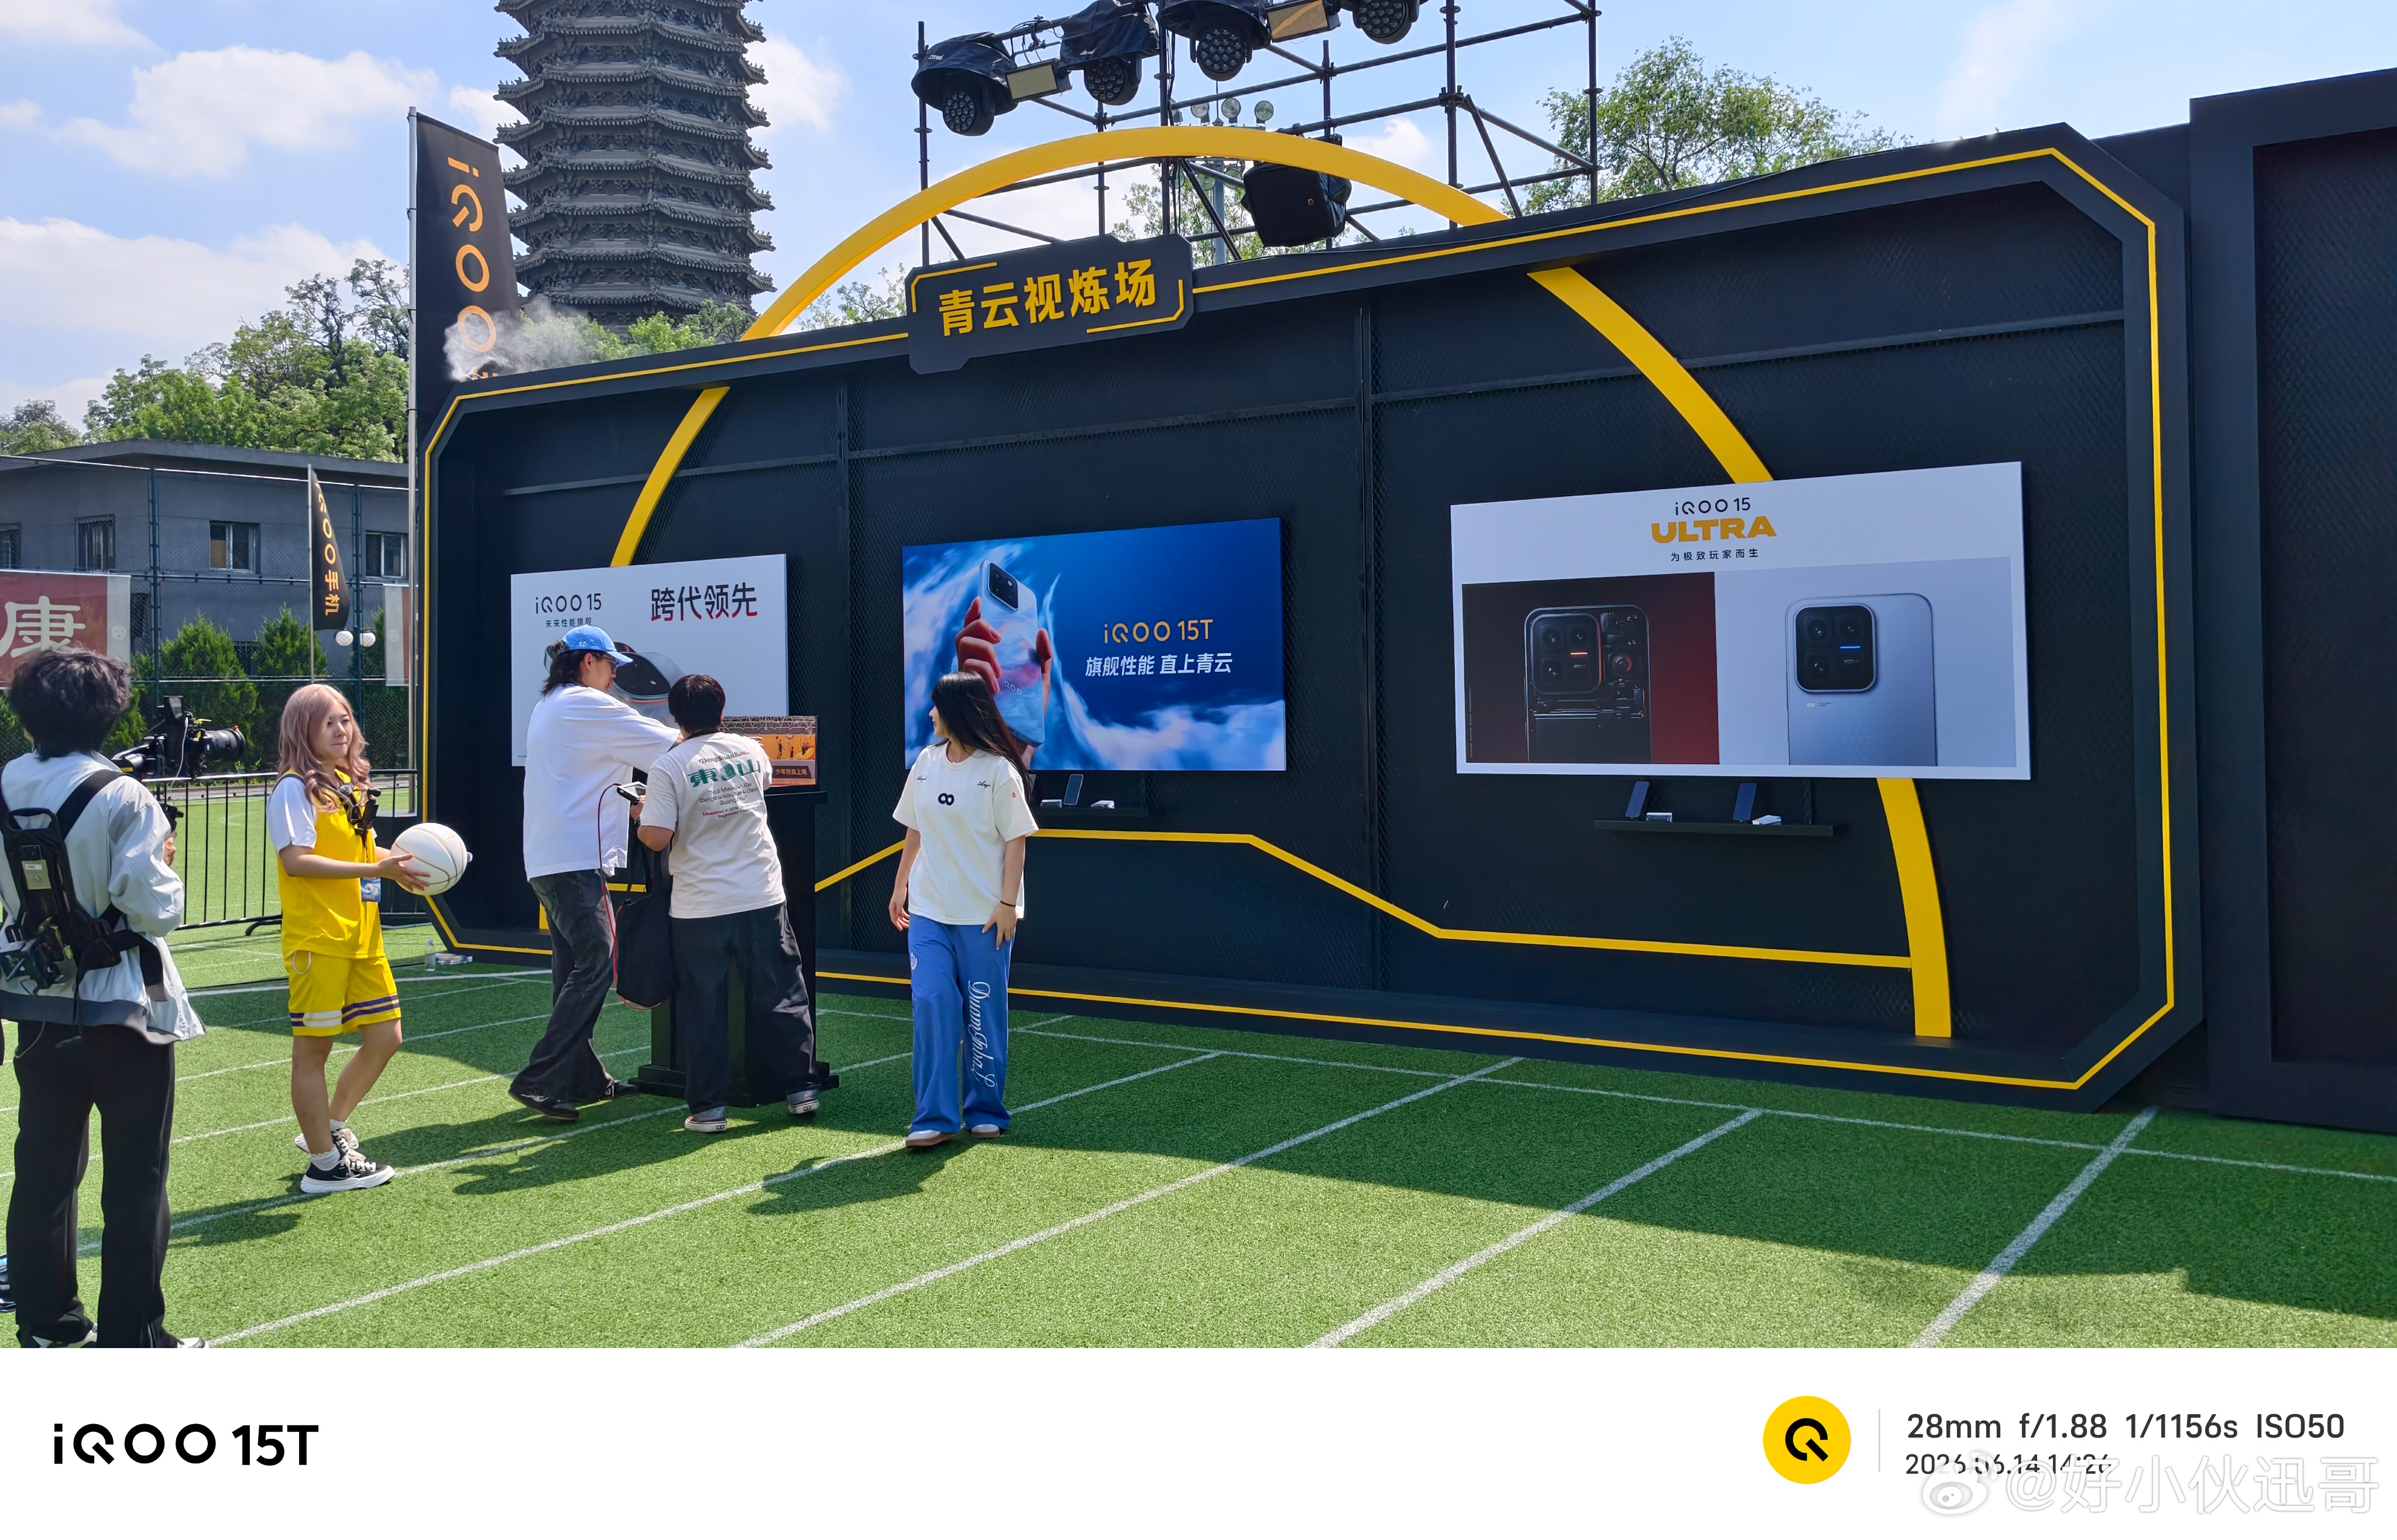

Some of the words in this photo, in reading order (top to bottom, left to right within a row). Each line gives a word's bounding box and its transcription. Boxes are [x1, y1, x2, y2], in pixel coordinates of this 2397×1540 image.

[939, 258, 1156, 336] 青云视炼场
[1675, 499, 1728, 515] iQOO
[1733, 497, 1751, 511] 15
[1651, 515, 1777, 544] ULTRA
[1671, 548, 1759, 562] 为极致玩家而生
[535, 594, 582, 614] iQOO
[586, 592, 602, 611] 15
[651, 582, 758, 621] 跨代领先
[0, 595, 86, 658] 康
[1104, 621, 1171, 644] iQOO
[1177, 618, 1214, 641] 15T
[1085, 654, 1154, 678] 旗舰性能
[1159, 652, 1233, 675] 直上青云
